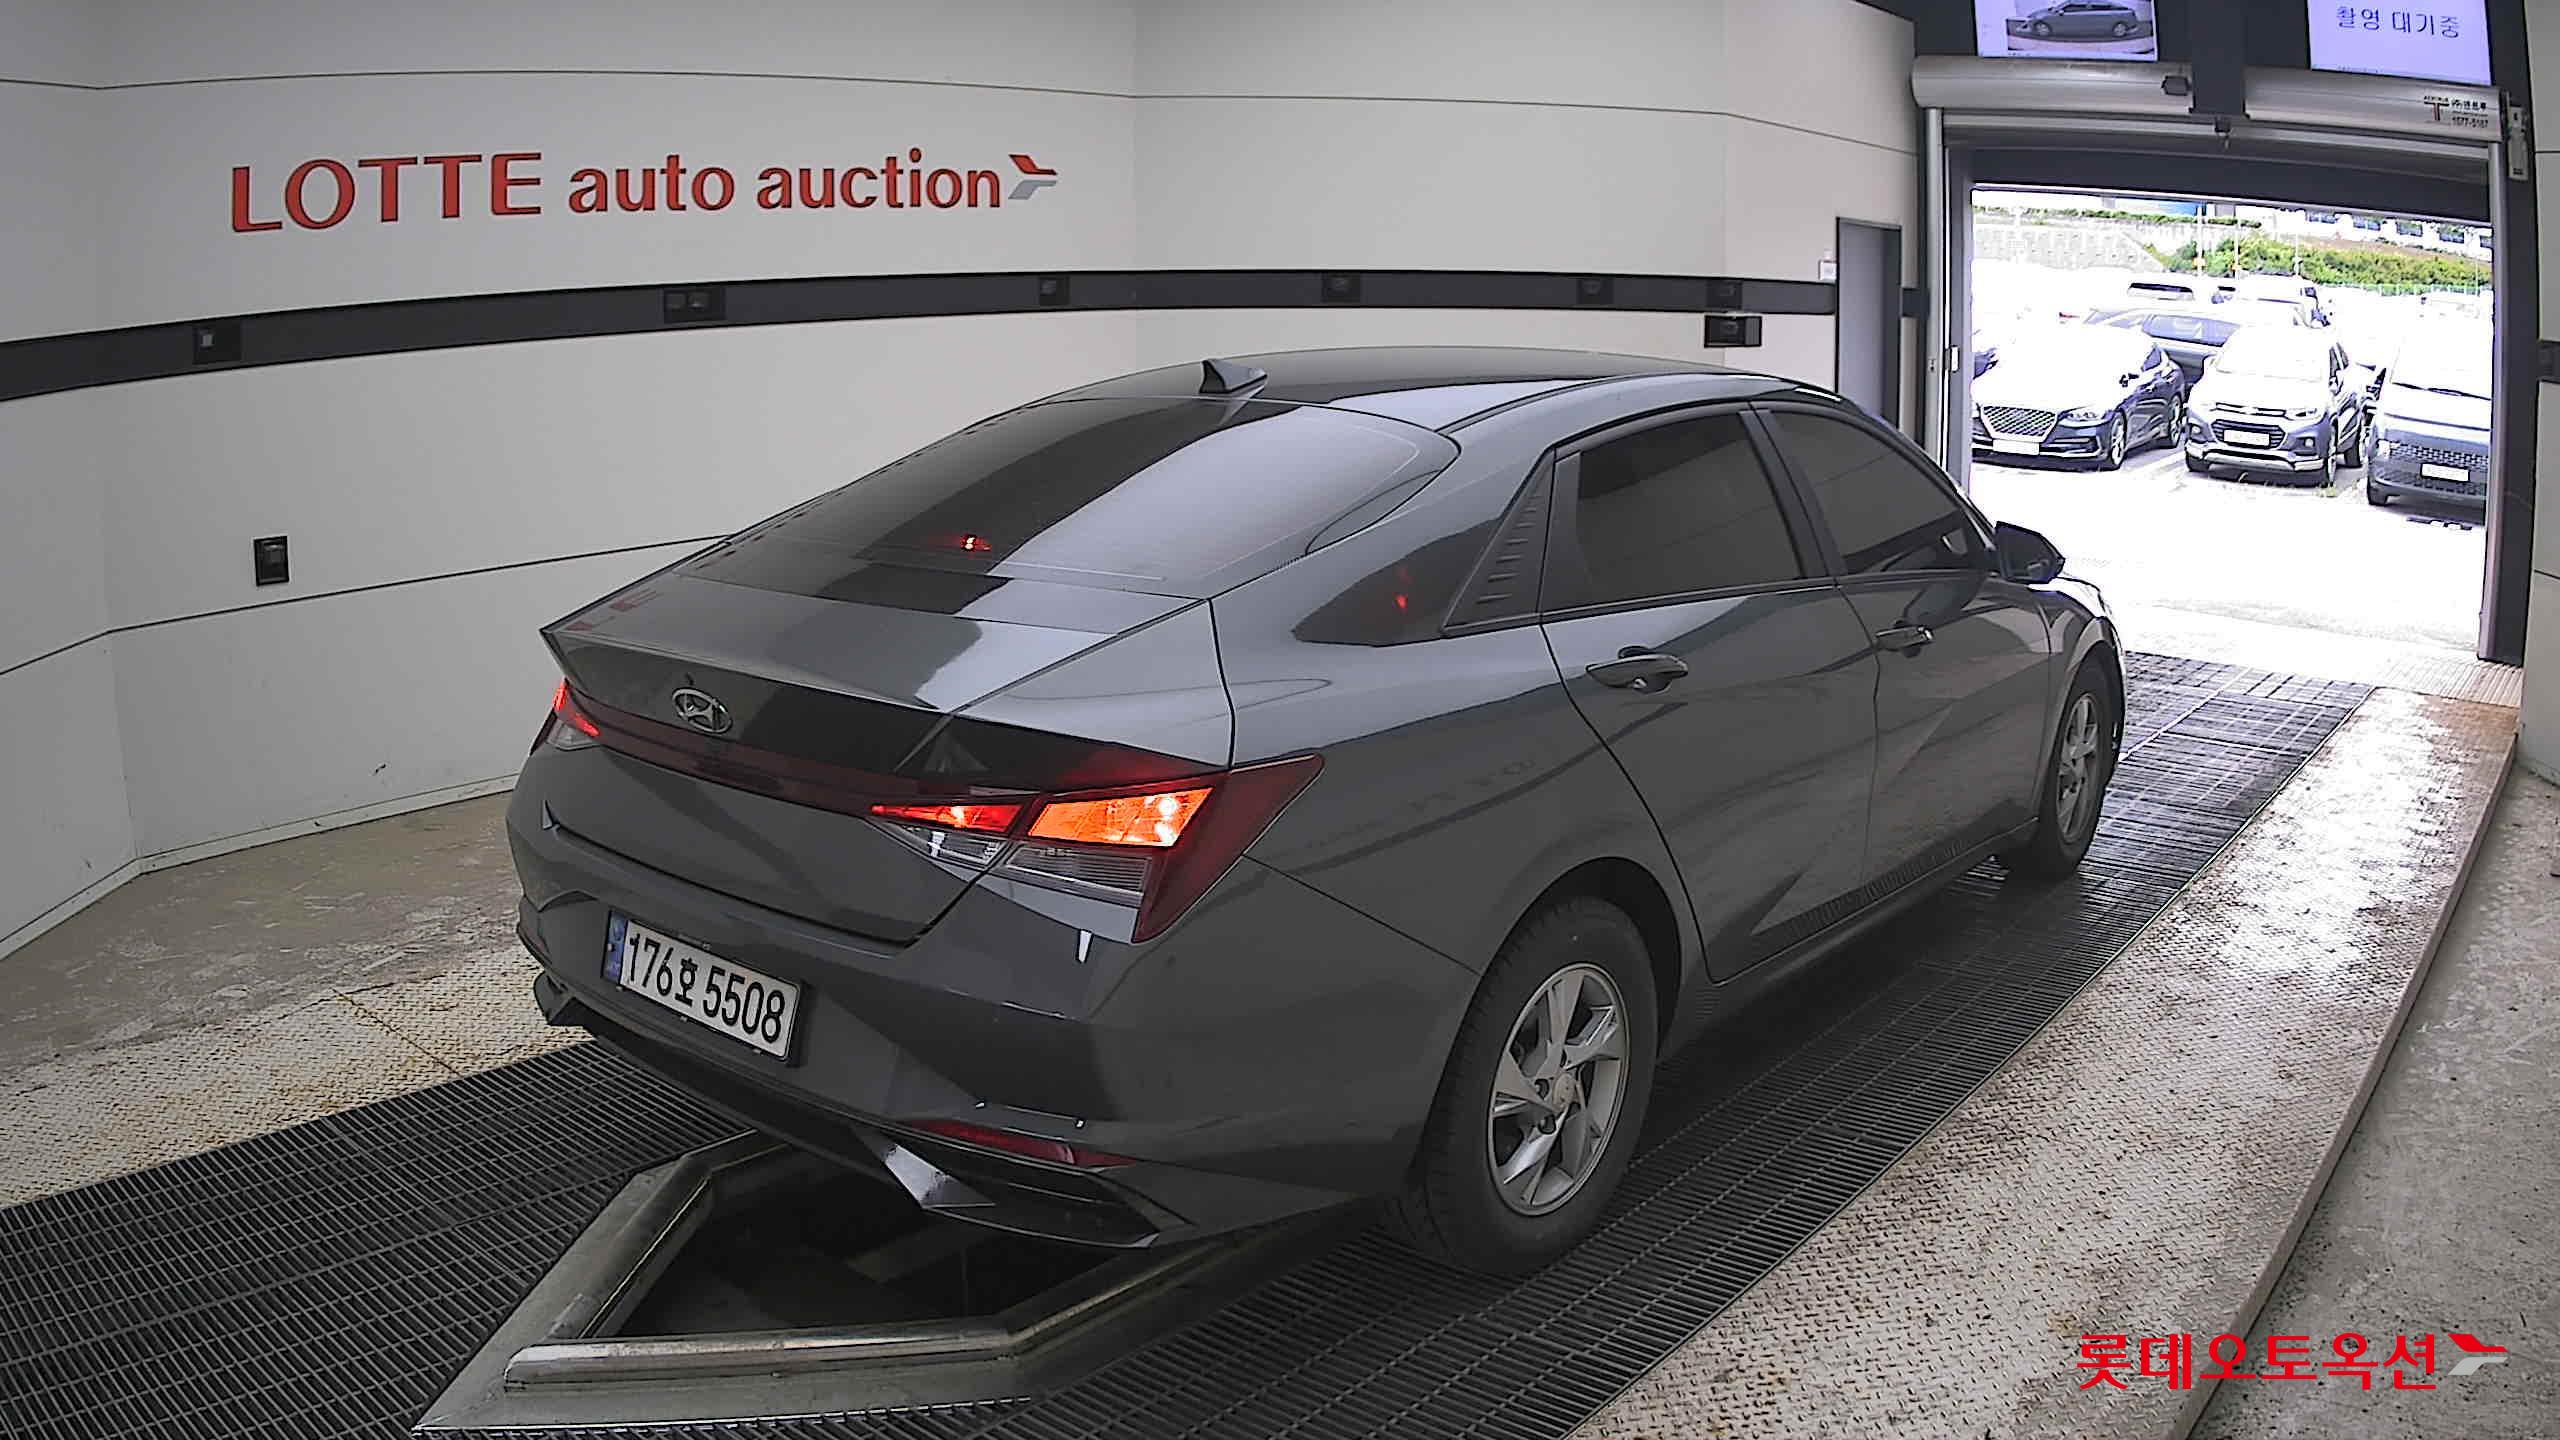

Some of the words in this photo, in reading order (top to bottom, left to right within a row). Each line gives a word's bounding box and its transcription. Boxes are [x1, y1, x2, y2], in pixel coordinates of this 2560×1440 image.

[2336, 5, 2380, 31] 촬영
[2391, 11, 2459, 39] 대기중
[231, 152, 542, 233] LOTTE
[568, 154, 735, 213] auto
[756, 147, 1000, 209] auction
[629, 933, 699, 1008] 176호
[702, 965, 786, 1044] 5508
